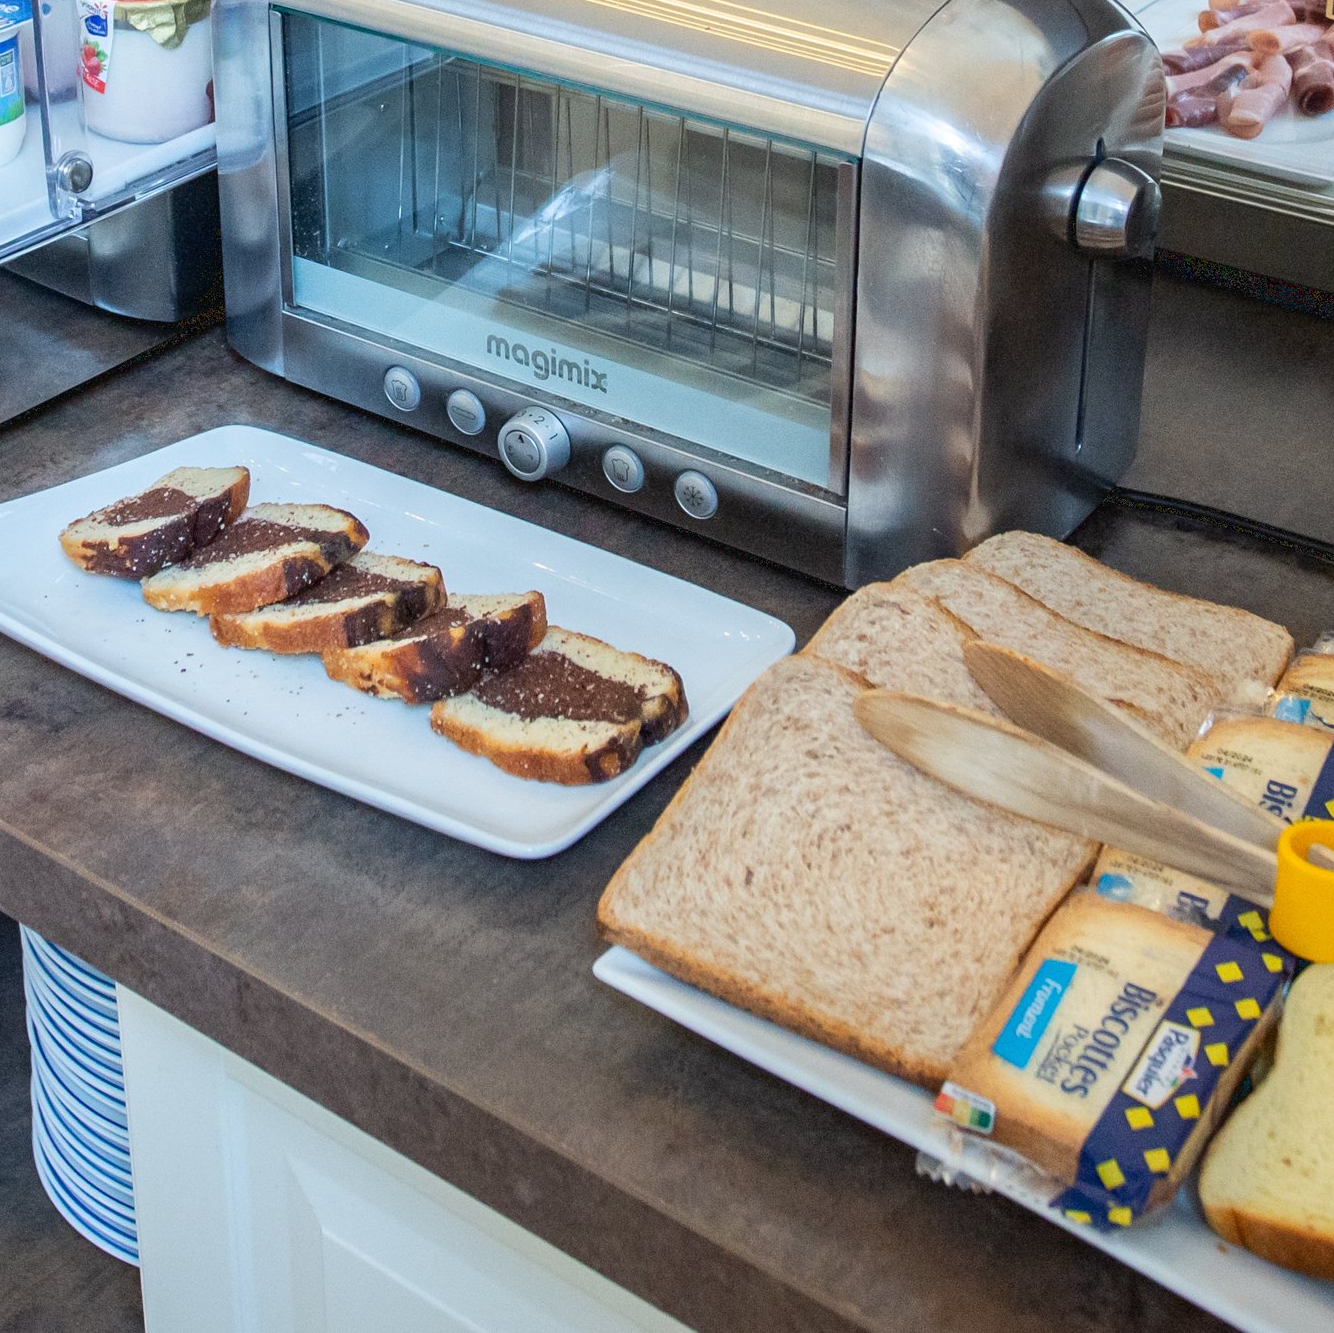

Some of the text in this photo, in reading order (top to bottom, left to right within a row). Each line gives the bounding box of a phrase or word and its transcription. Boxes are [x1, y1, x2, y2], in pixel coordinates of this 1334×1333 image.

[486, 333, 609, 395] magimix
[533, 415, 546, 425] 2
[1015, 977, 1062, 1039] Froment
[1034, 1023, 1089, 1084] Pocket
[1060, 982, 1158, 1099] Biscottes
[1135, 1027, 1190, 1096] Pasquier
